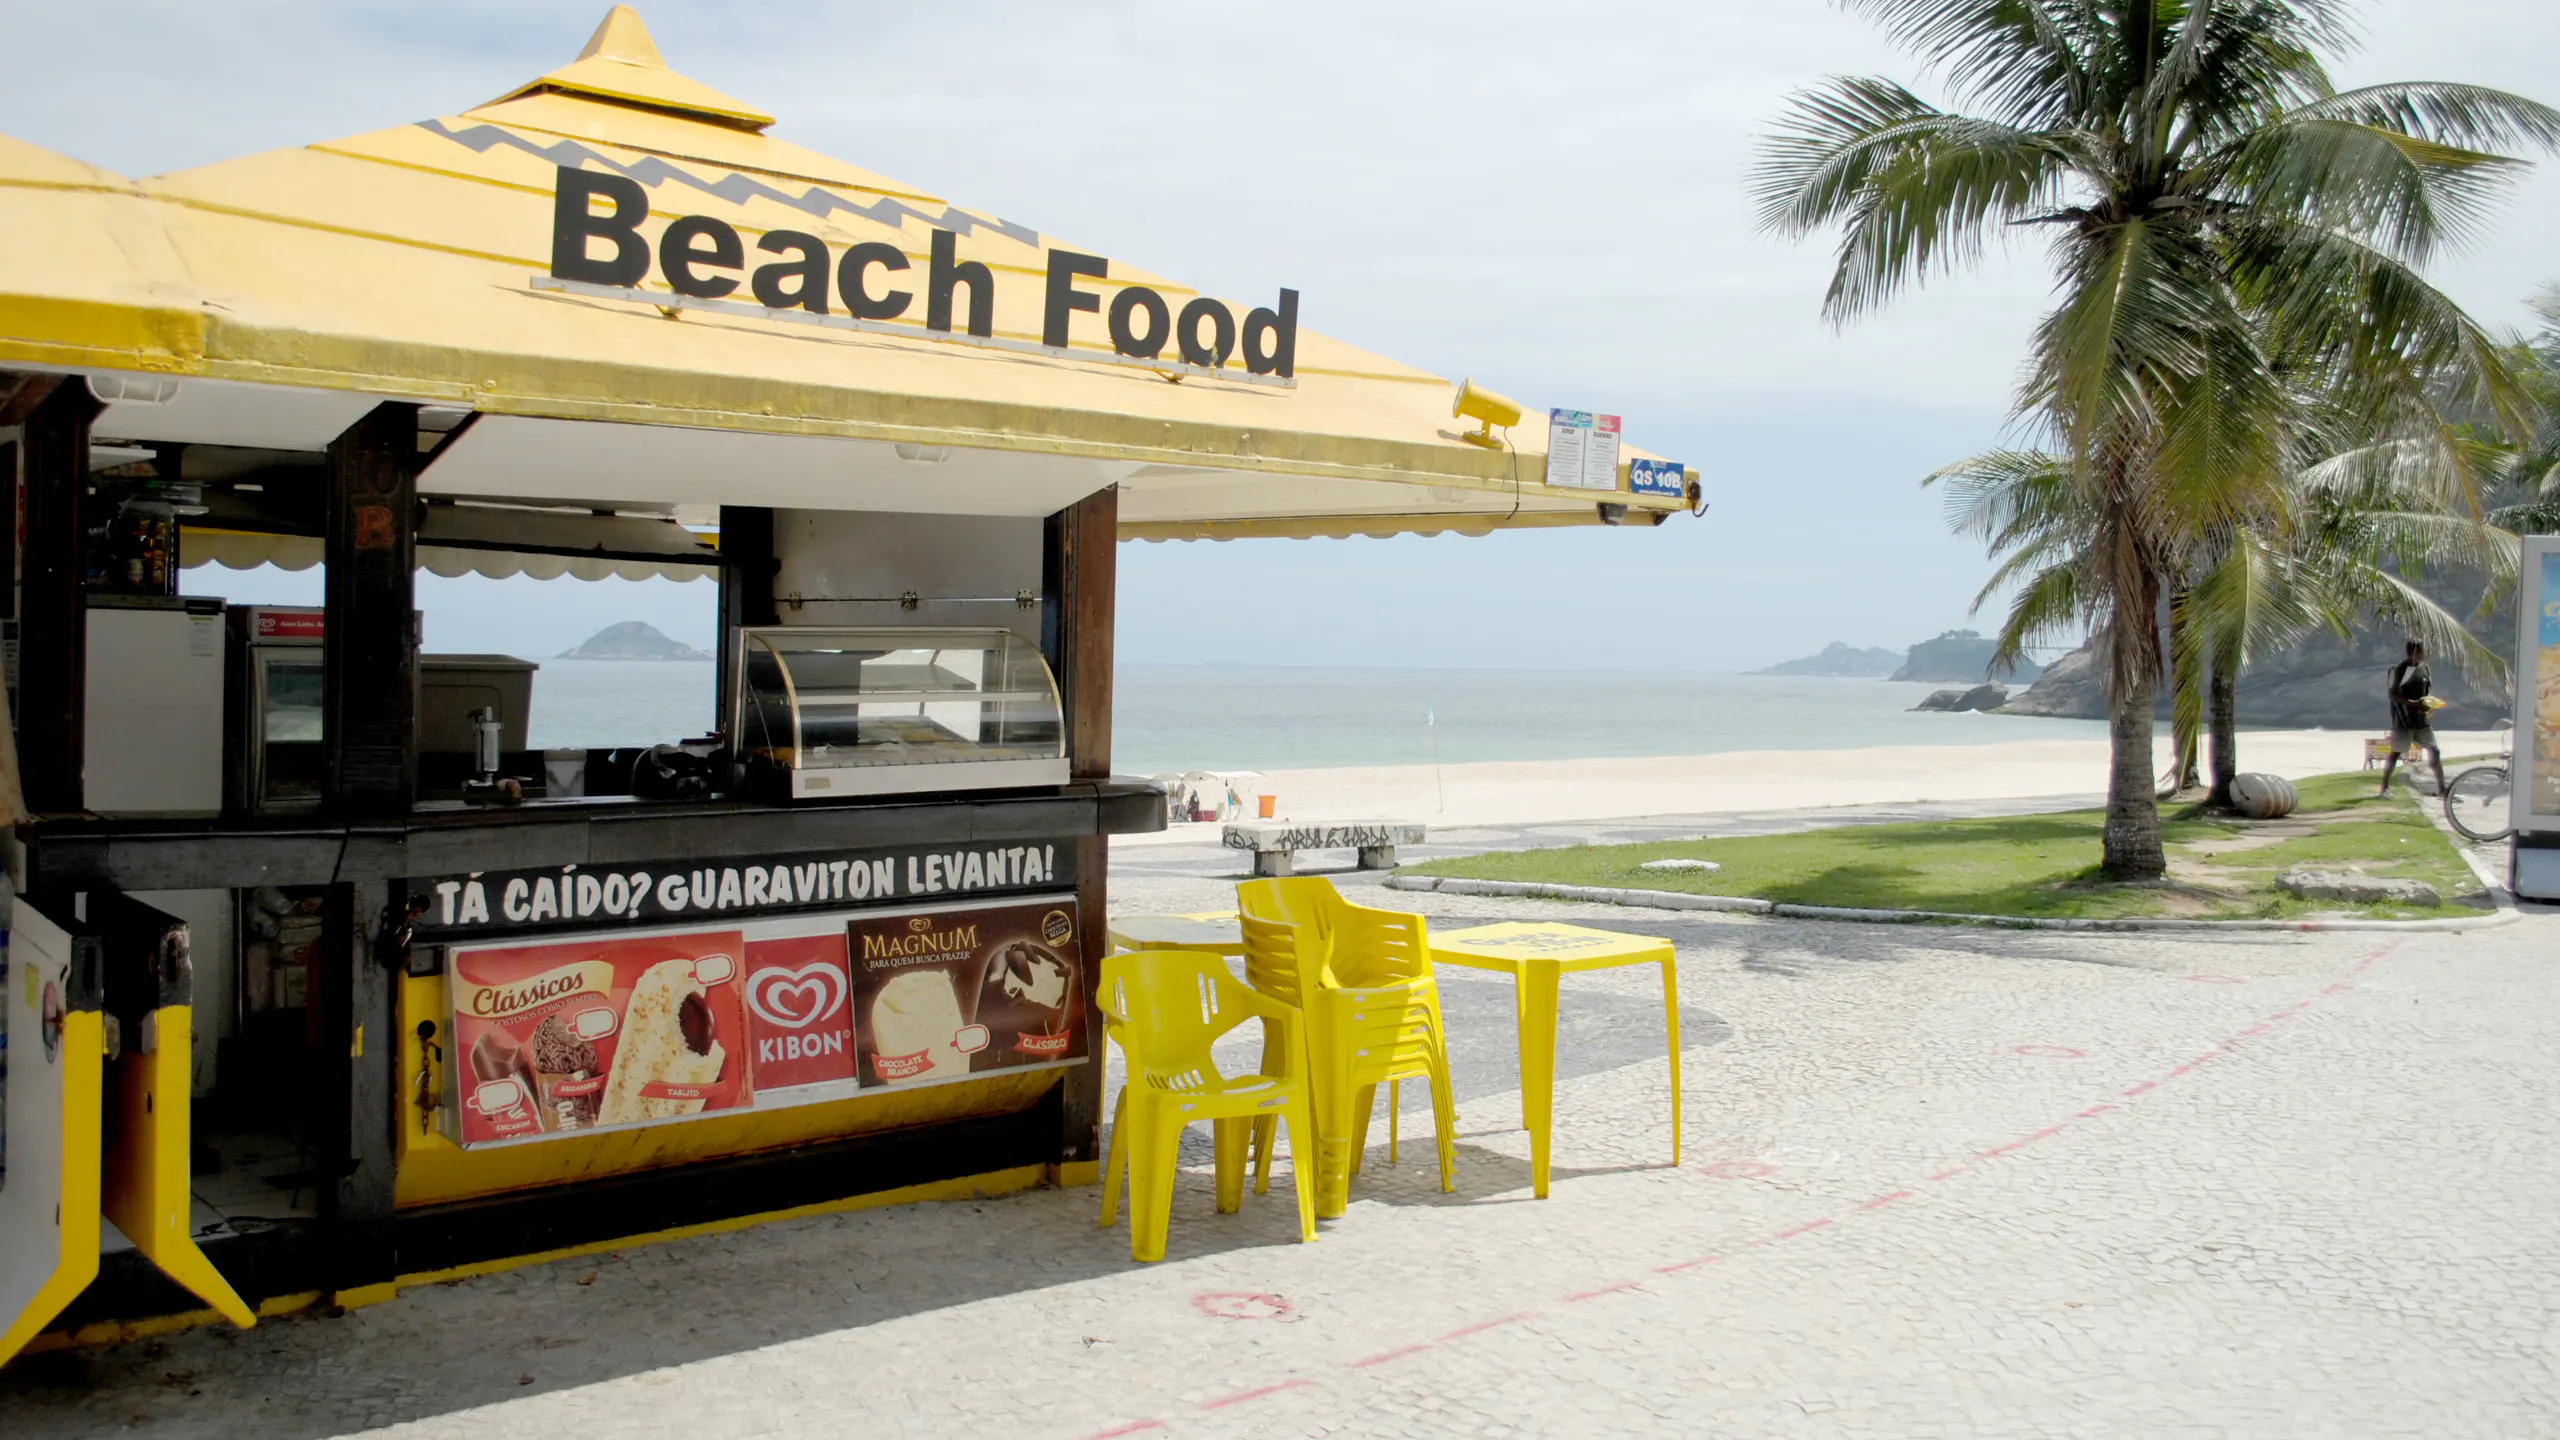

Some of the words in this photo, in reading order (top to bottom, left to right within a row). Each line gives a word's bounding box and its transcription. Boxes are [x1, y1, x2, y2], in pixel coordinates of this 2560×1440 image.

[551, 165, 994, 338] Beach
[1042, 248, 1299, 378] Food
[1634, 469, 1653, 486] QS
[1656, 471, 1681, 488] 10B
[355, 506, 395, 548] B
[436, 871, 490, 925] TÁ
[503, 864, 652, 922] CAÍDO?
[657, 857, 895, 911] GUARAVITON
[908, 845, 1054, 894] LEVANTA!
[863, 925, 977, 959] MAGNUM
[870, 959, 889, 969] PARA
[890, 957, 915, 968] QUEM
[915, 954, 941, 964] BUSCA
[941, 951, 971, 961] PRAZER
[473, 971, 584, 1015] Clássicos
[537, 1001, 565, 1016] COMO
[760, 1030, 842, 1063] KIBON
[1022, 1036, 1067, 1050] CLÁSSICO
[878, 1054, 923, 1068] CHOCOLATE
[887, 1065, 919, 1076] BRANCO
[667, 1088, 700, 1097] TABLITO
